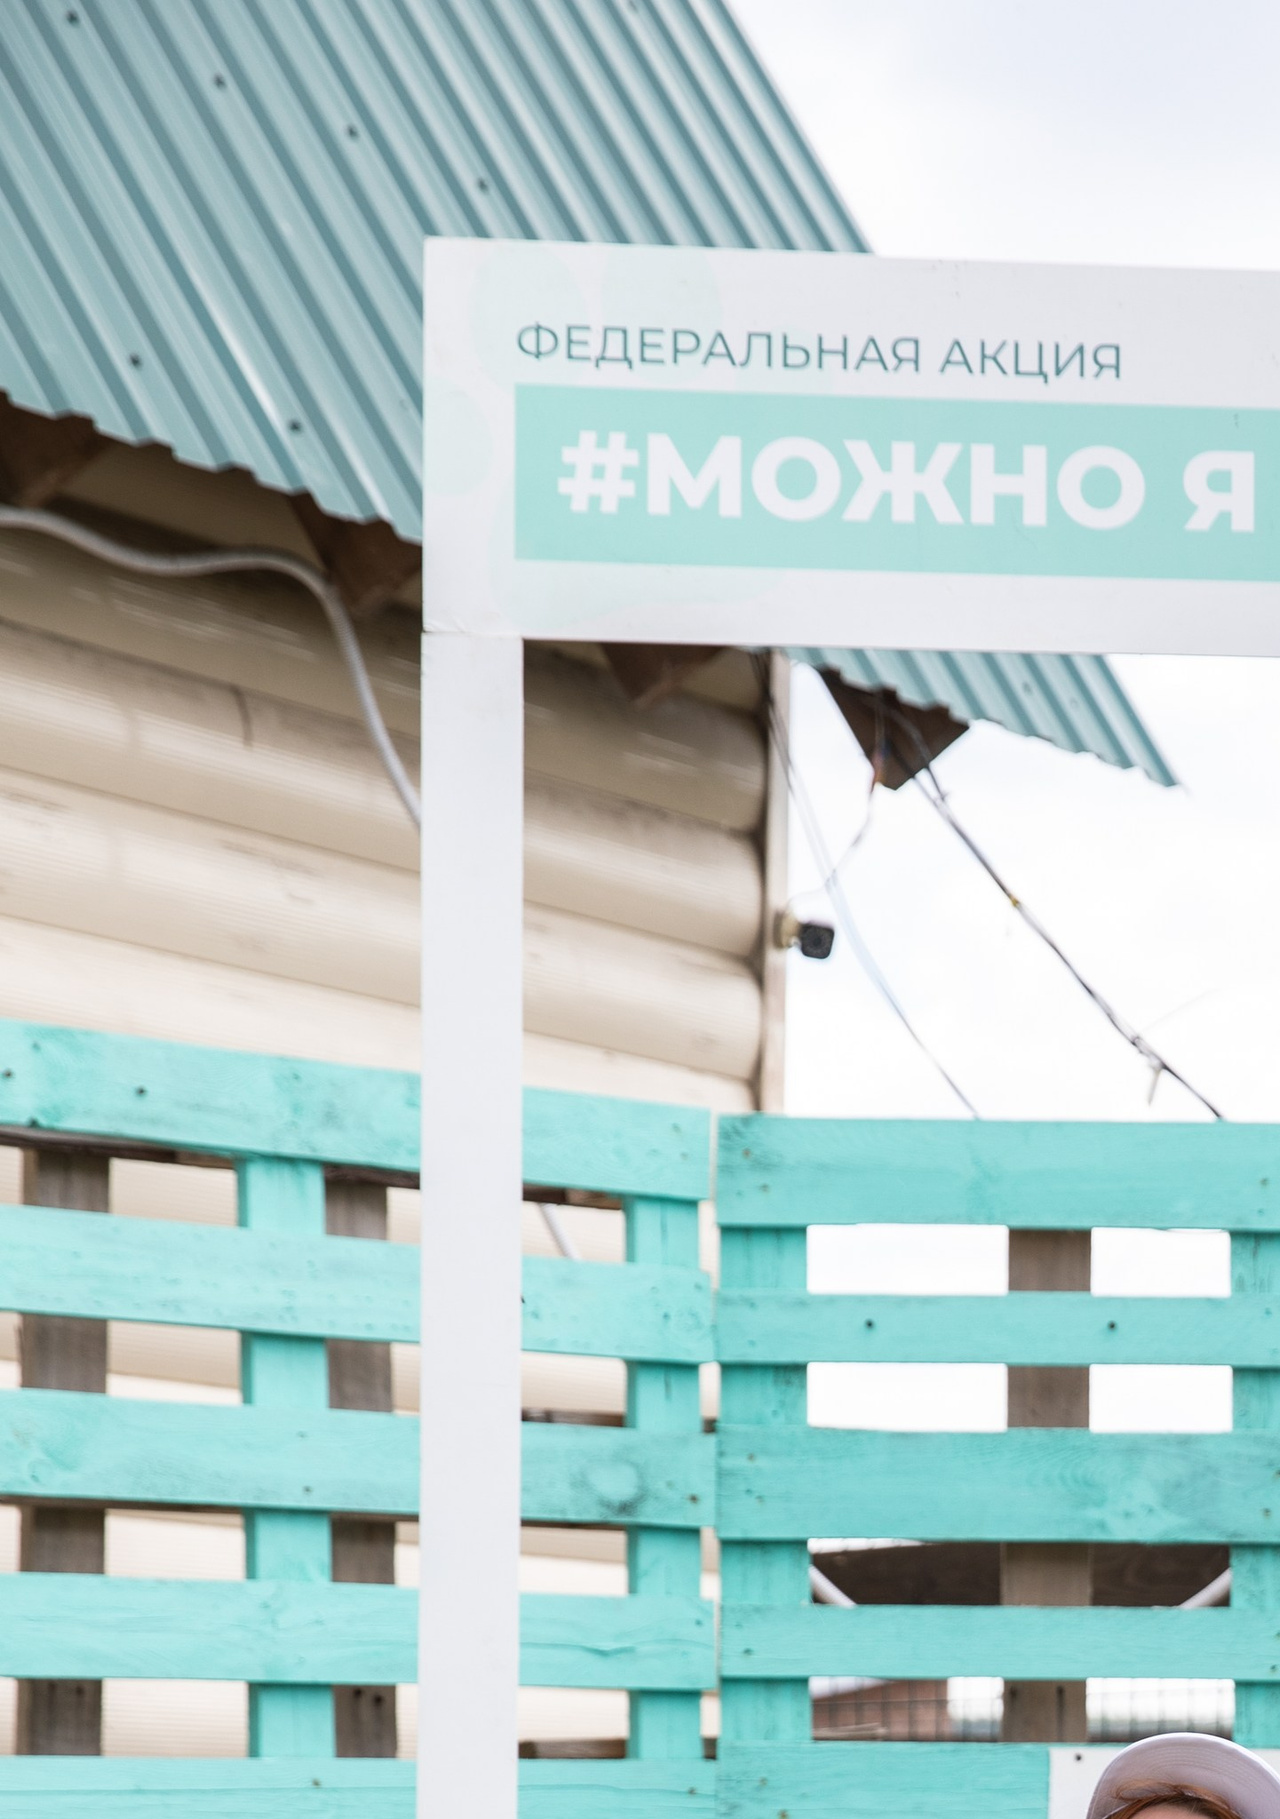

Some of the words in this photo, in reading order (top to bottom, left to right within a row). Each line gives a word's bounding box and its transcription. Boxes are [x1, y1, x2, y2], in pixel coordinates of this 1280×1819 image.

[516, 321, 922, 374] ФЕДЕРАЛЬНАЯ
[940, 338, 1122, 384] АКЦИЯ
[557, 429, 1146, 531] #МОЖНО
[1183, 449, 1257, 533] Я
